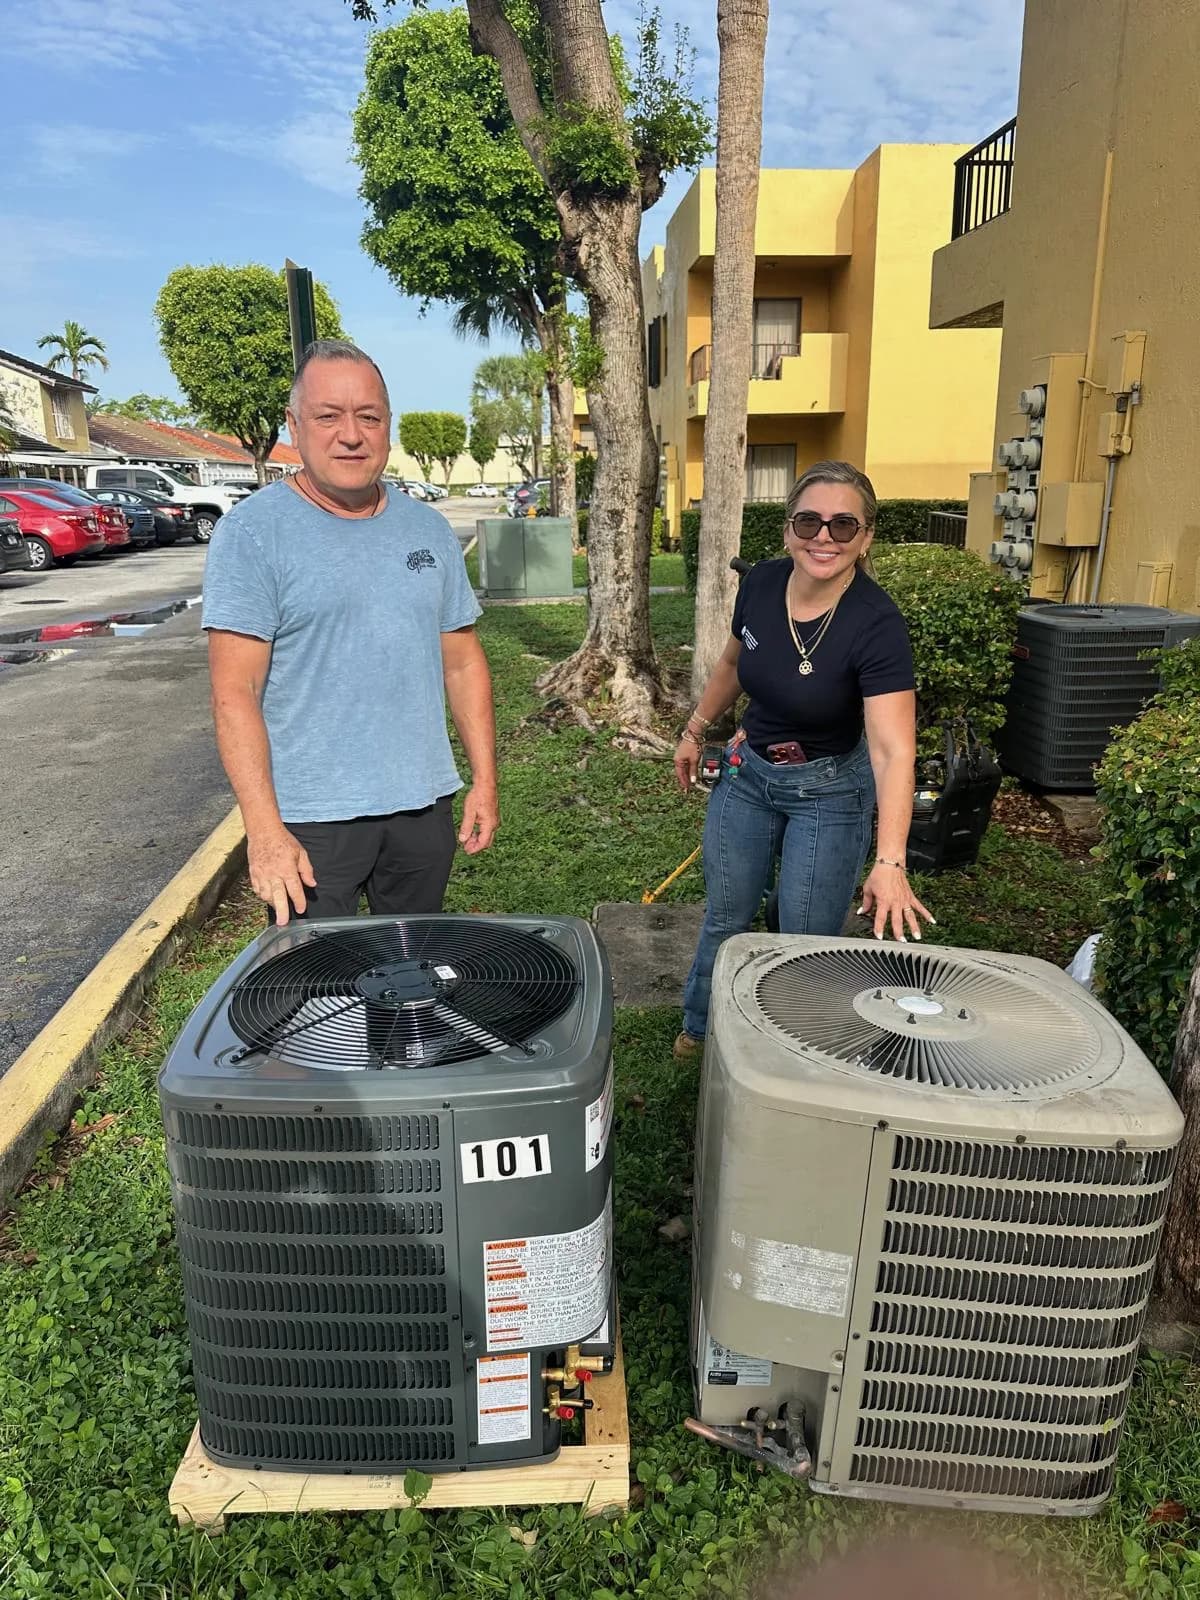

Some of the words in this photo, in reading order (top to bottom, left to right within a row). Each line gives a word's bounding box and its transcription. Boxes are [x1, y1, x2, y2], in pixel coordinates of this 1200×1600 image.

[471, 1138, 543, 1178] 101
[494, 1241, 526, 1249] WARNING
[494, 1272, 527, 1280] WARNING
[496, 1304, 528, 1312] WARNING
